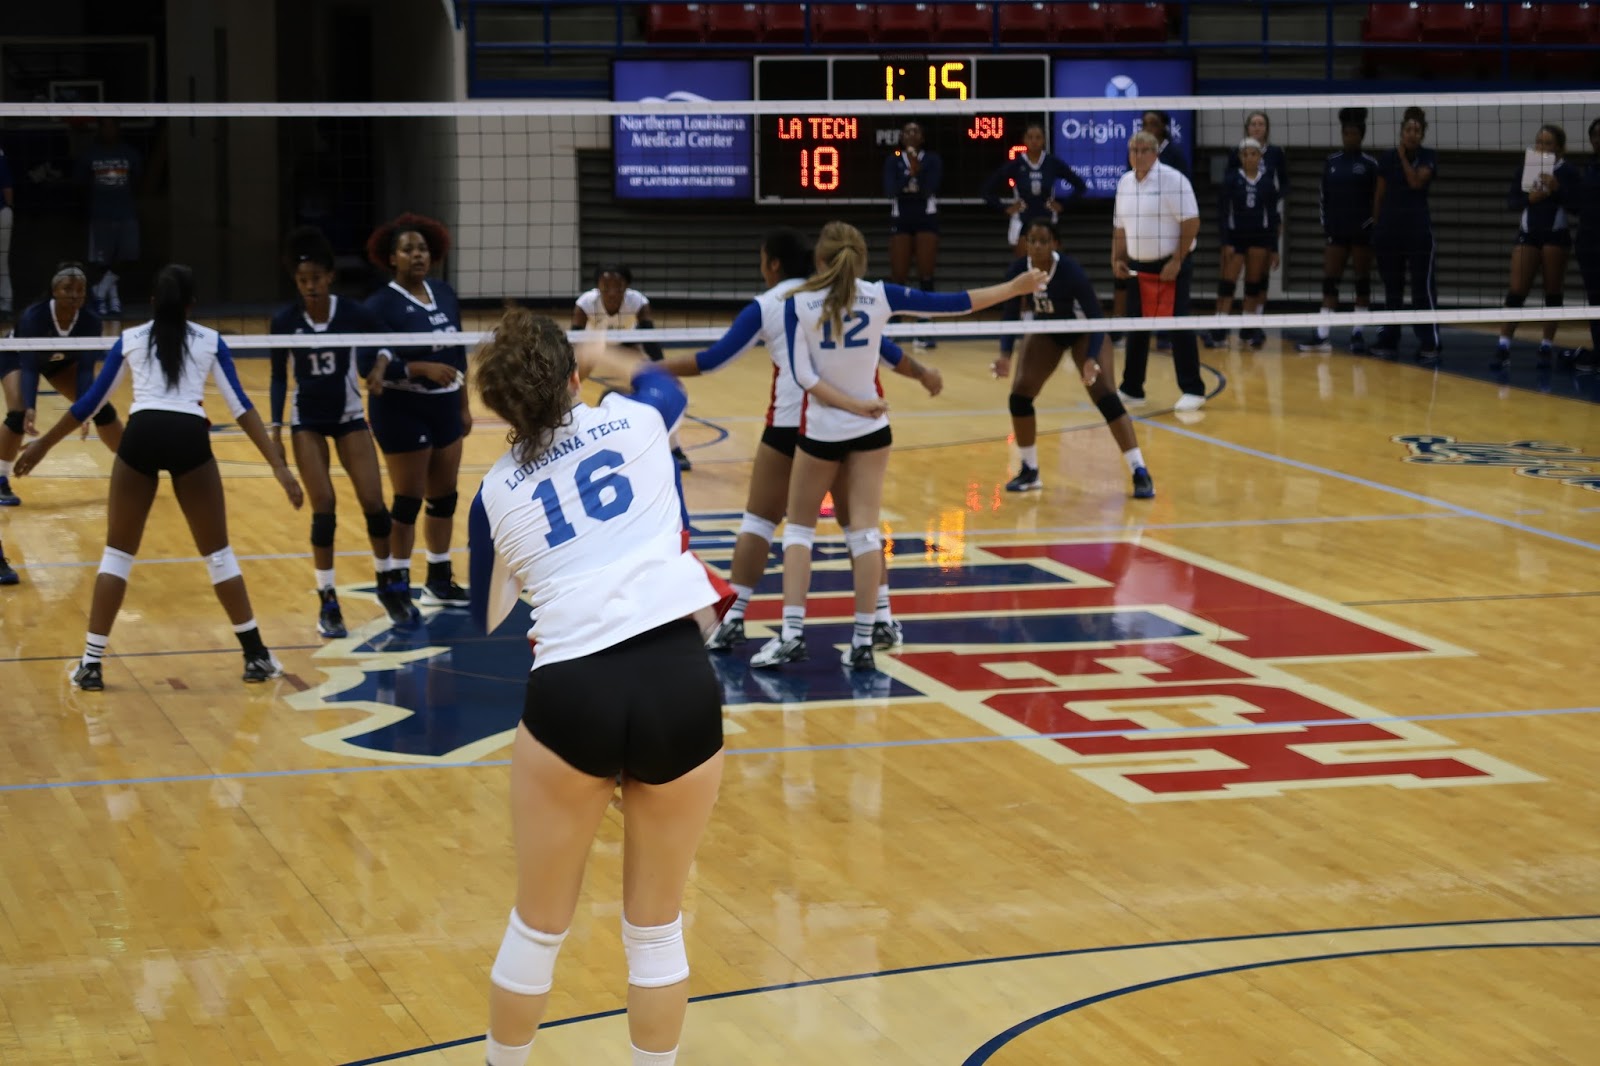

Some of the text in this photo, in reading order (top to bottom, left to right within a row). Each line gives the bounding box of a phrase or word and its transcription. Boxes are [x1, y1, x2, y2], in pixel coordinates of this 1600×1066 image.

[886, 62, 967, 101] 1:15
[620, 114, 746, 131] Northern Louisiana
[778, 117, 857, 139] LA TECH
[968, 116, 1003, 139] JSU
[1061, 116, 1182, 144] Origin Bk
[631, 131, 734, 148] Medical Center
[801, 146, 839, 190] 18
[819, 310, 870, 349] 12
[307, 351, 336, 376] 13
[504, 417, 631, 491] LOUISIANA TECH
[531, 448, 635, 549] 16
